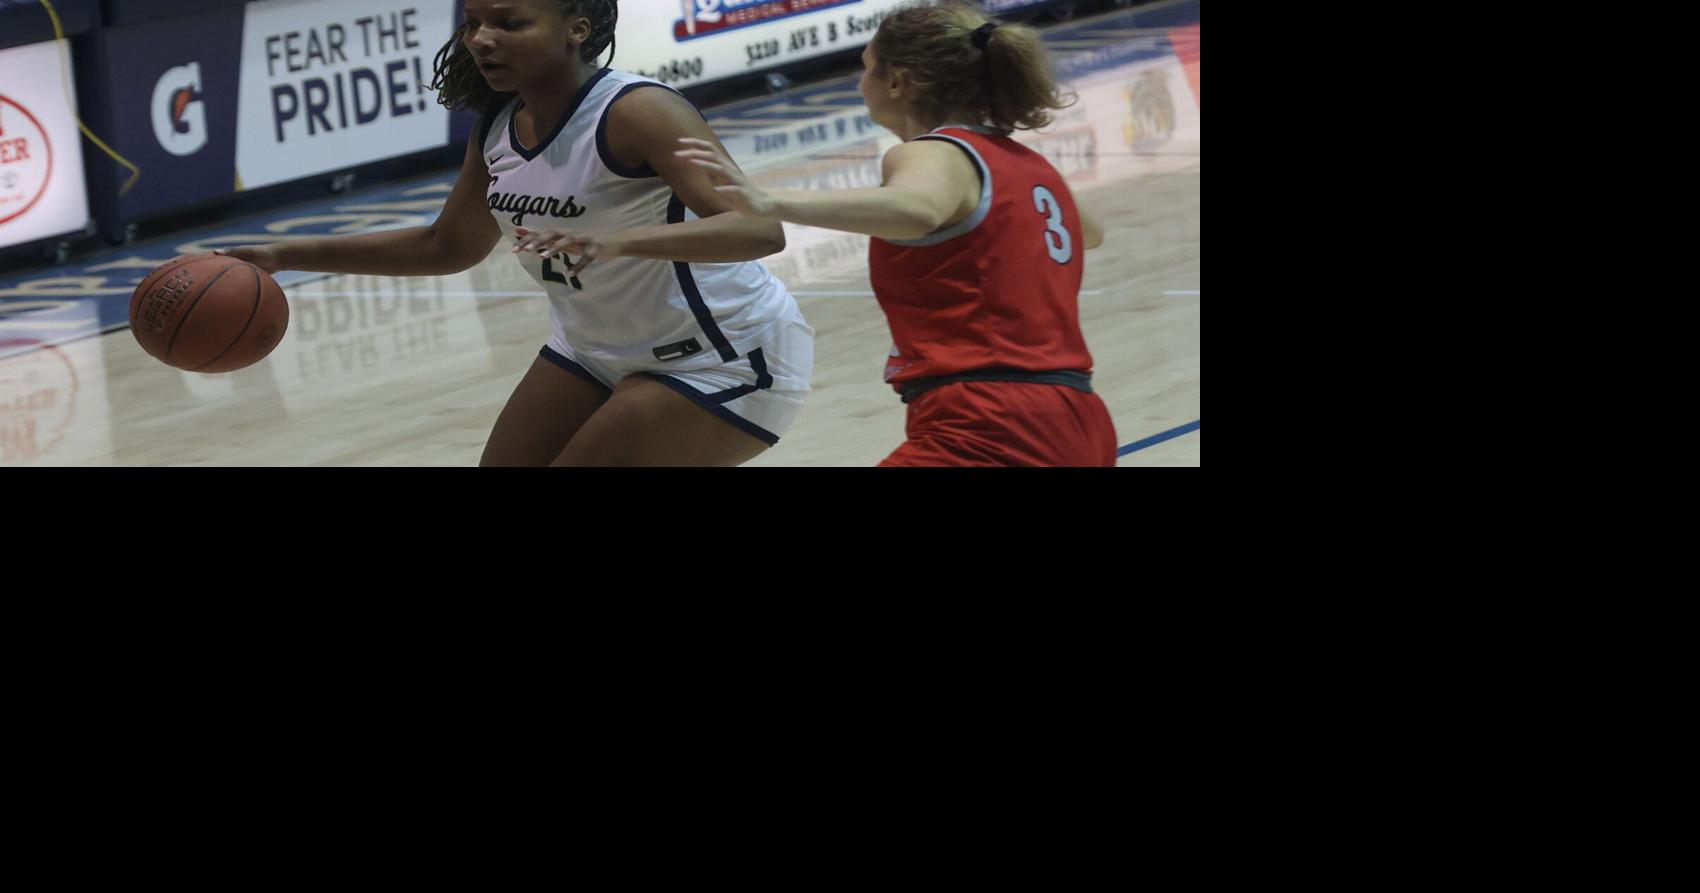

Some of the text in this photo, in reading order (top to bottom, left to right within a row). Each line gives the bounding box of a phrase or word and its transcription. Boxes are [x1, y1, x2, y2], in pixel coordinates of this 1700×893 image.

[265, 8, 420, 77] FEAR THE
[787, 25, 820, 51] AVE
[827, 21, 838, 42] B
[271, 56, 426, 142] PRIDE!
[1032, 184, 1073, 265] 3
